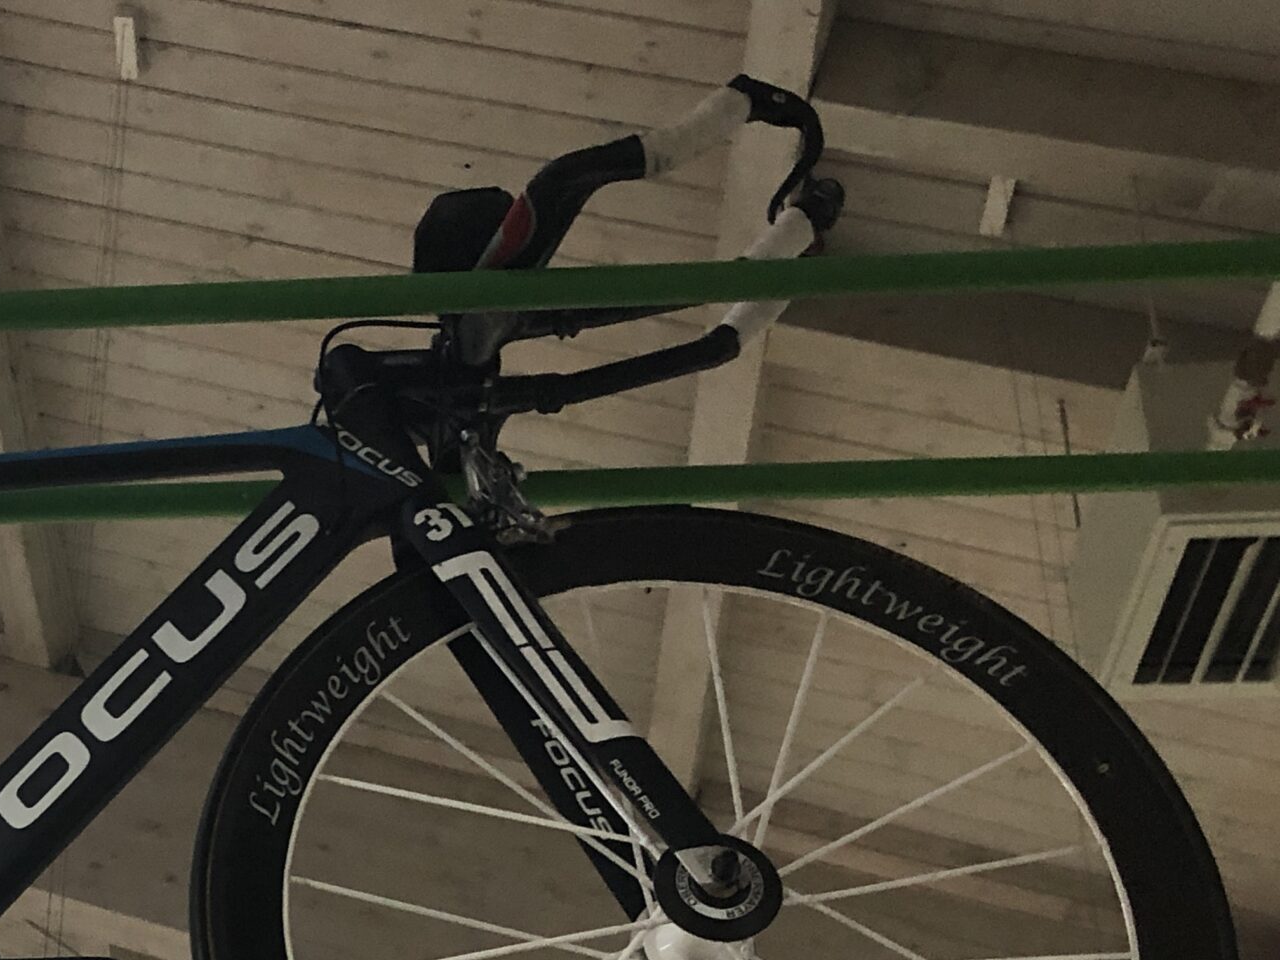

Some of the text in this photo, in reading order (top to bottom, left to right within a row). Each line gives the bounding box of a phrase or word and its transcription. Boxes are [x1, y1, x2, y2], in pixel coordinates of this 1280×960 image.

[413, 502, 474, 541] 31
[757, 549, 1028, 687] Lightweight
[249, 616, 412, 826] Lightweight
[531, 718, 615, 839] FOCUS
[609, 758, 661, 820] FUNDA PRO
